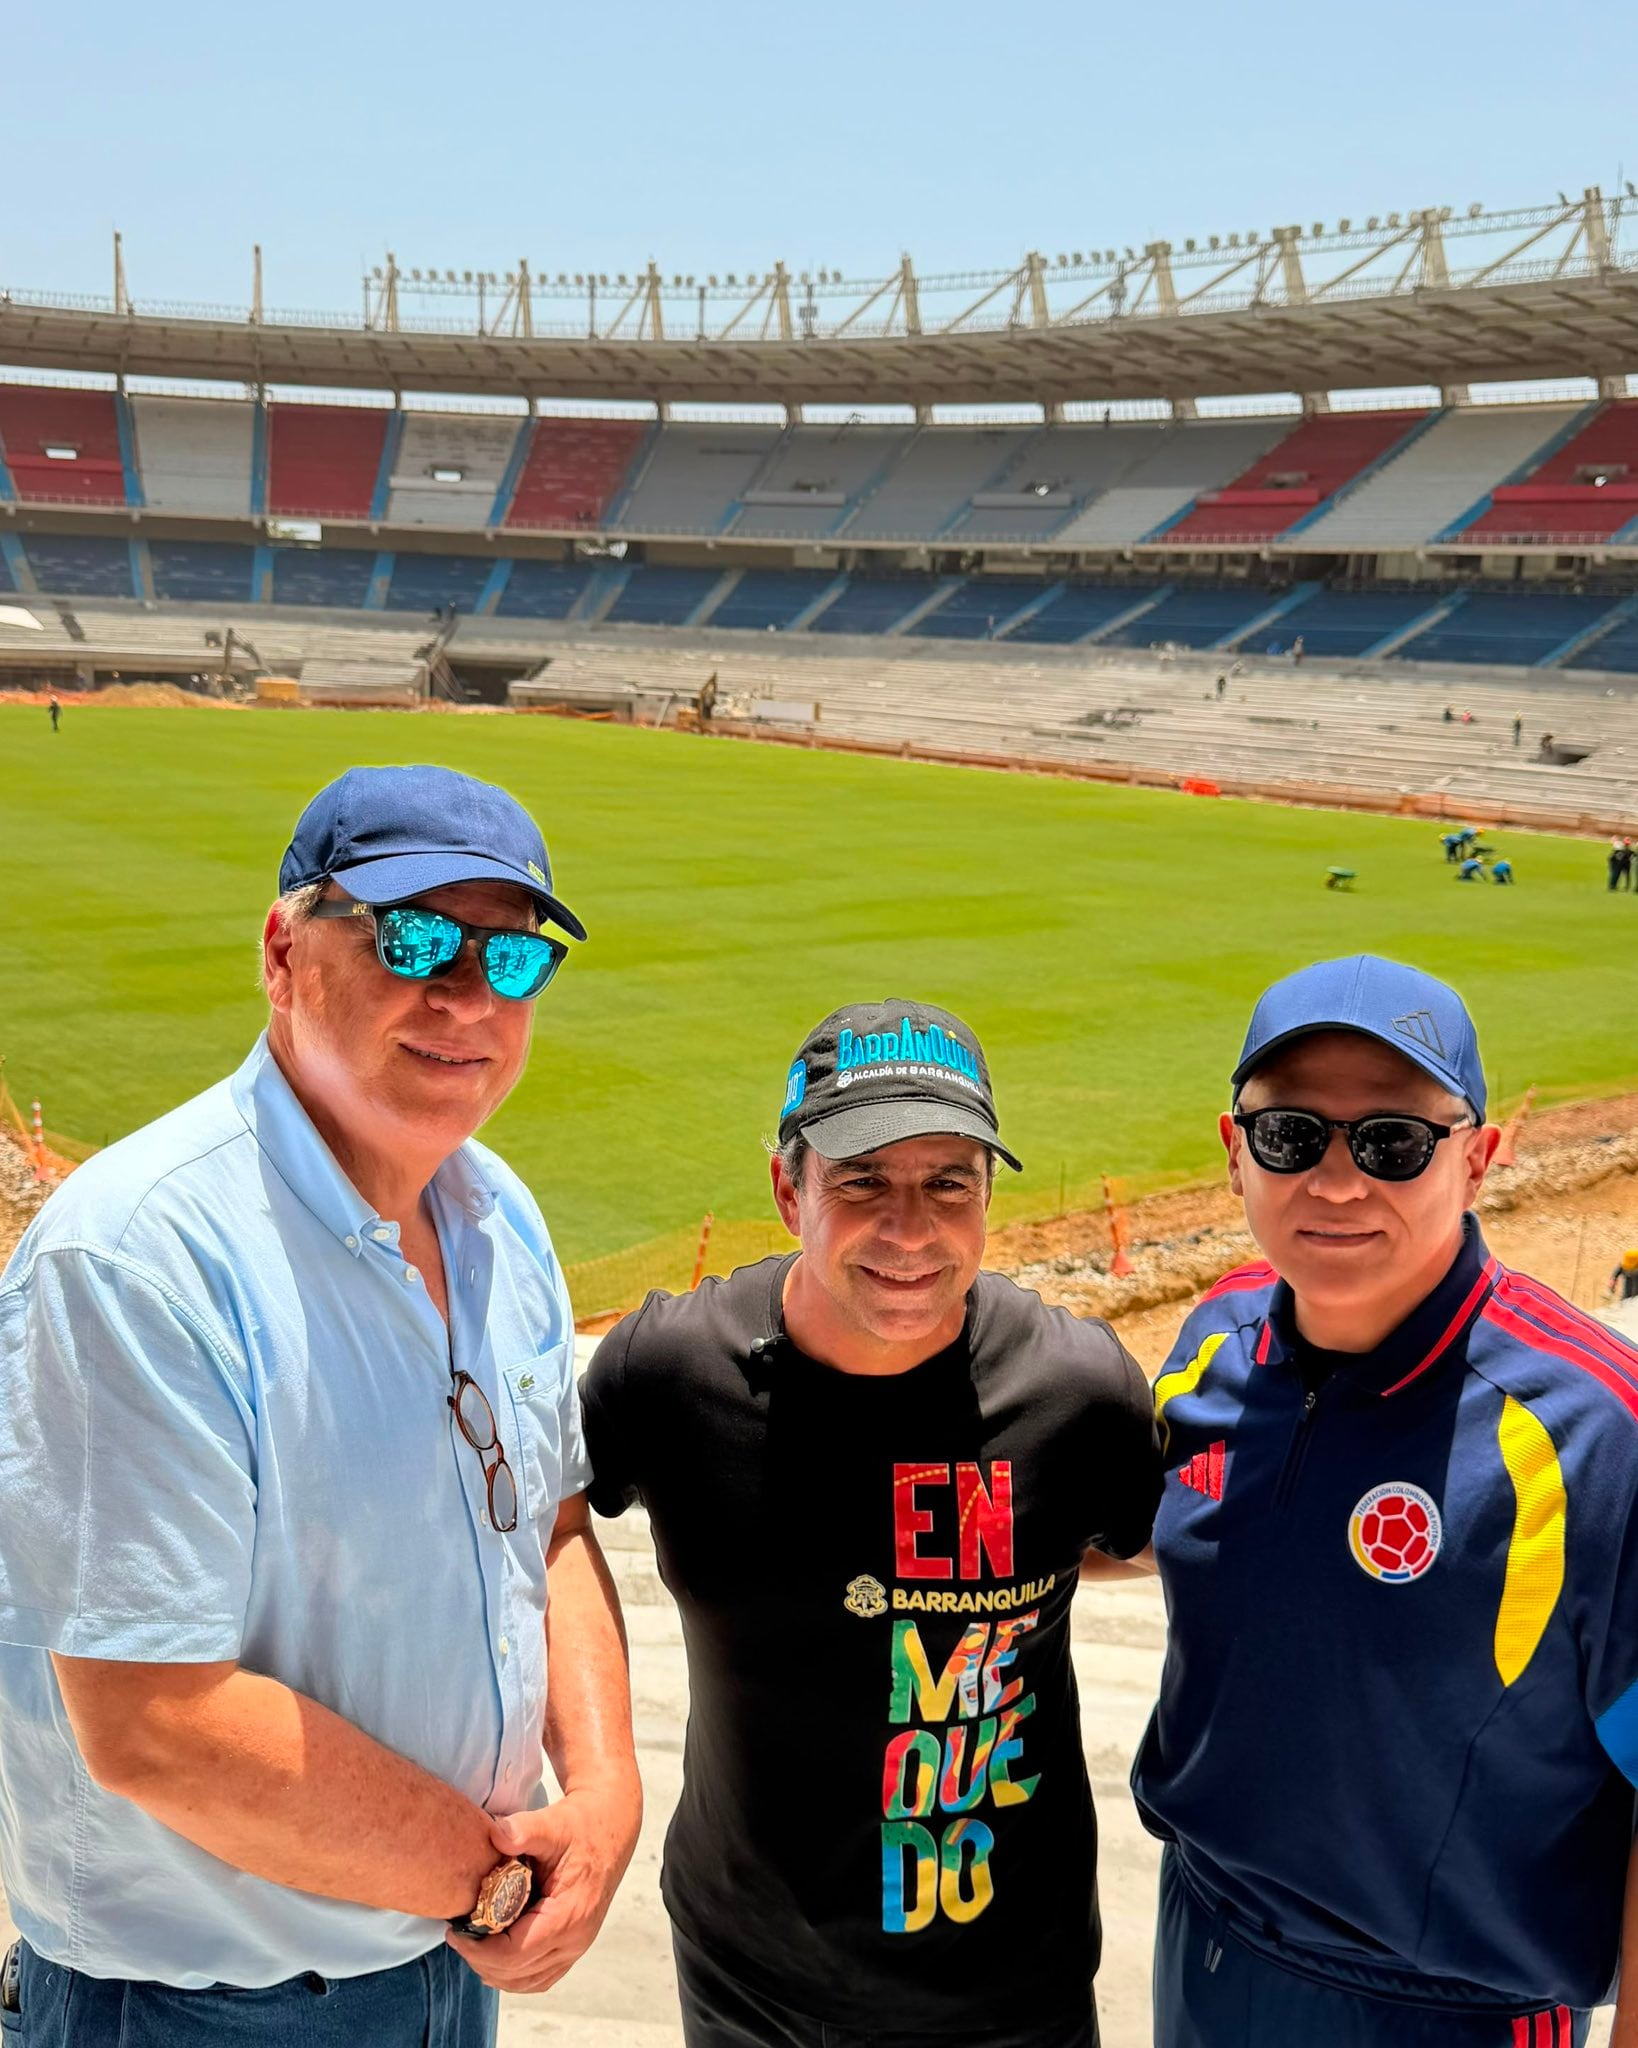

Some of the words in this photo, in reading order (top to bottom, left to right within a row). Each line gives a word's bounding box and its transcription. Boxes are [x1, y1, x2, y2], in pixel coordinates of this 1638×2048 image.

[896, 1066, 908, 1075] DE
[893, 1460, 1015, 1580] EN
[892, 1573, 1056, 1613] BARRANQUILLA
[888, 1608, 1040, 1724] ME
[881, 1817, 995, 1933] DO
